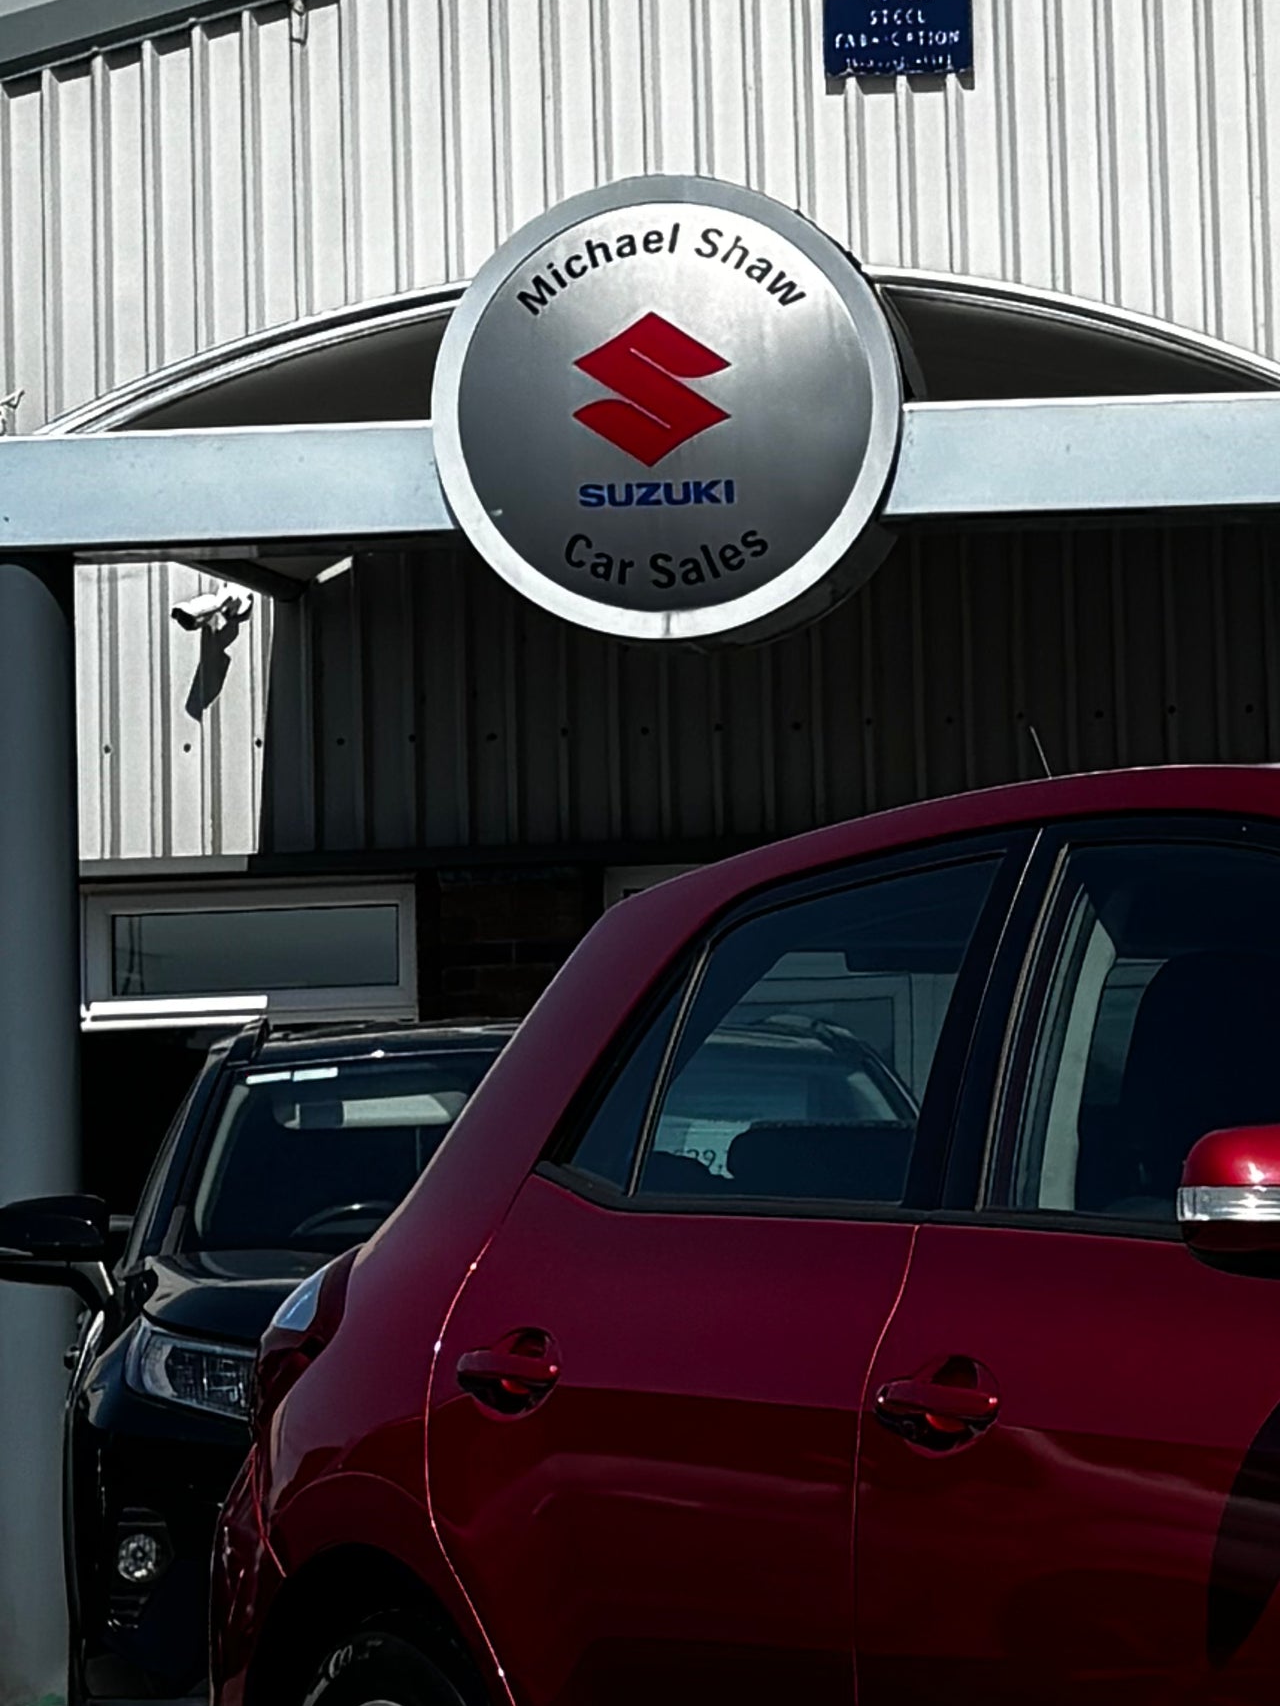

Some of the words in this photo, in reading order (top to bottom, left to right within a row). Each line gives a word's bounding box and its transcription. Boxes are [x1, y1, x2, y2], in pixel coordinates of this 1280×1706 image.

[516, 223, 680, 317] Michael
[694, 228, 807, 309] Shaw
[578, 479, 735, 508] SUZUKI
[564, 532, 635, 586] Car
[651, 528, 770, 590] Sales
